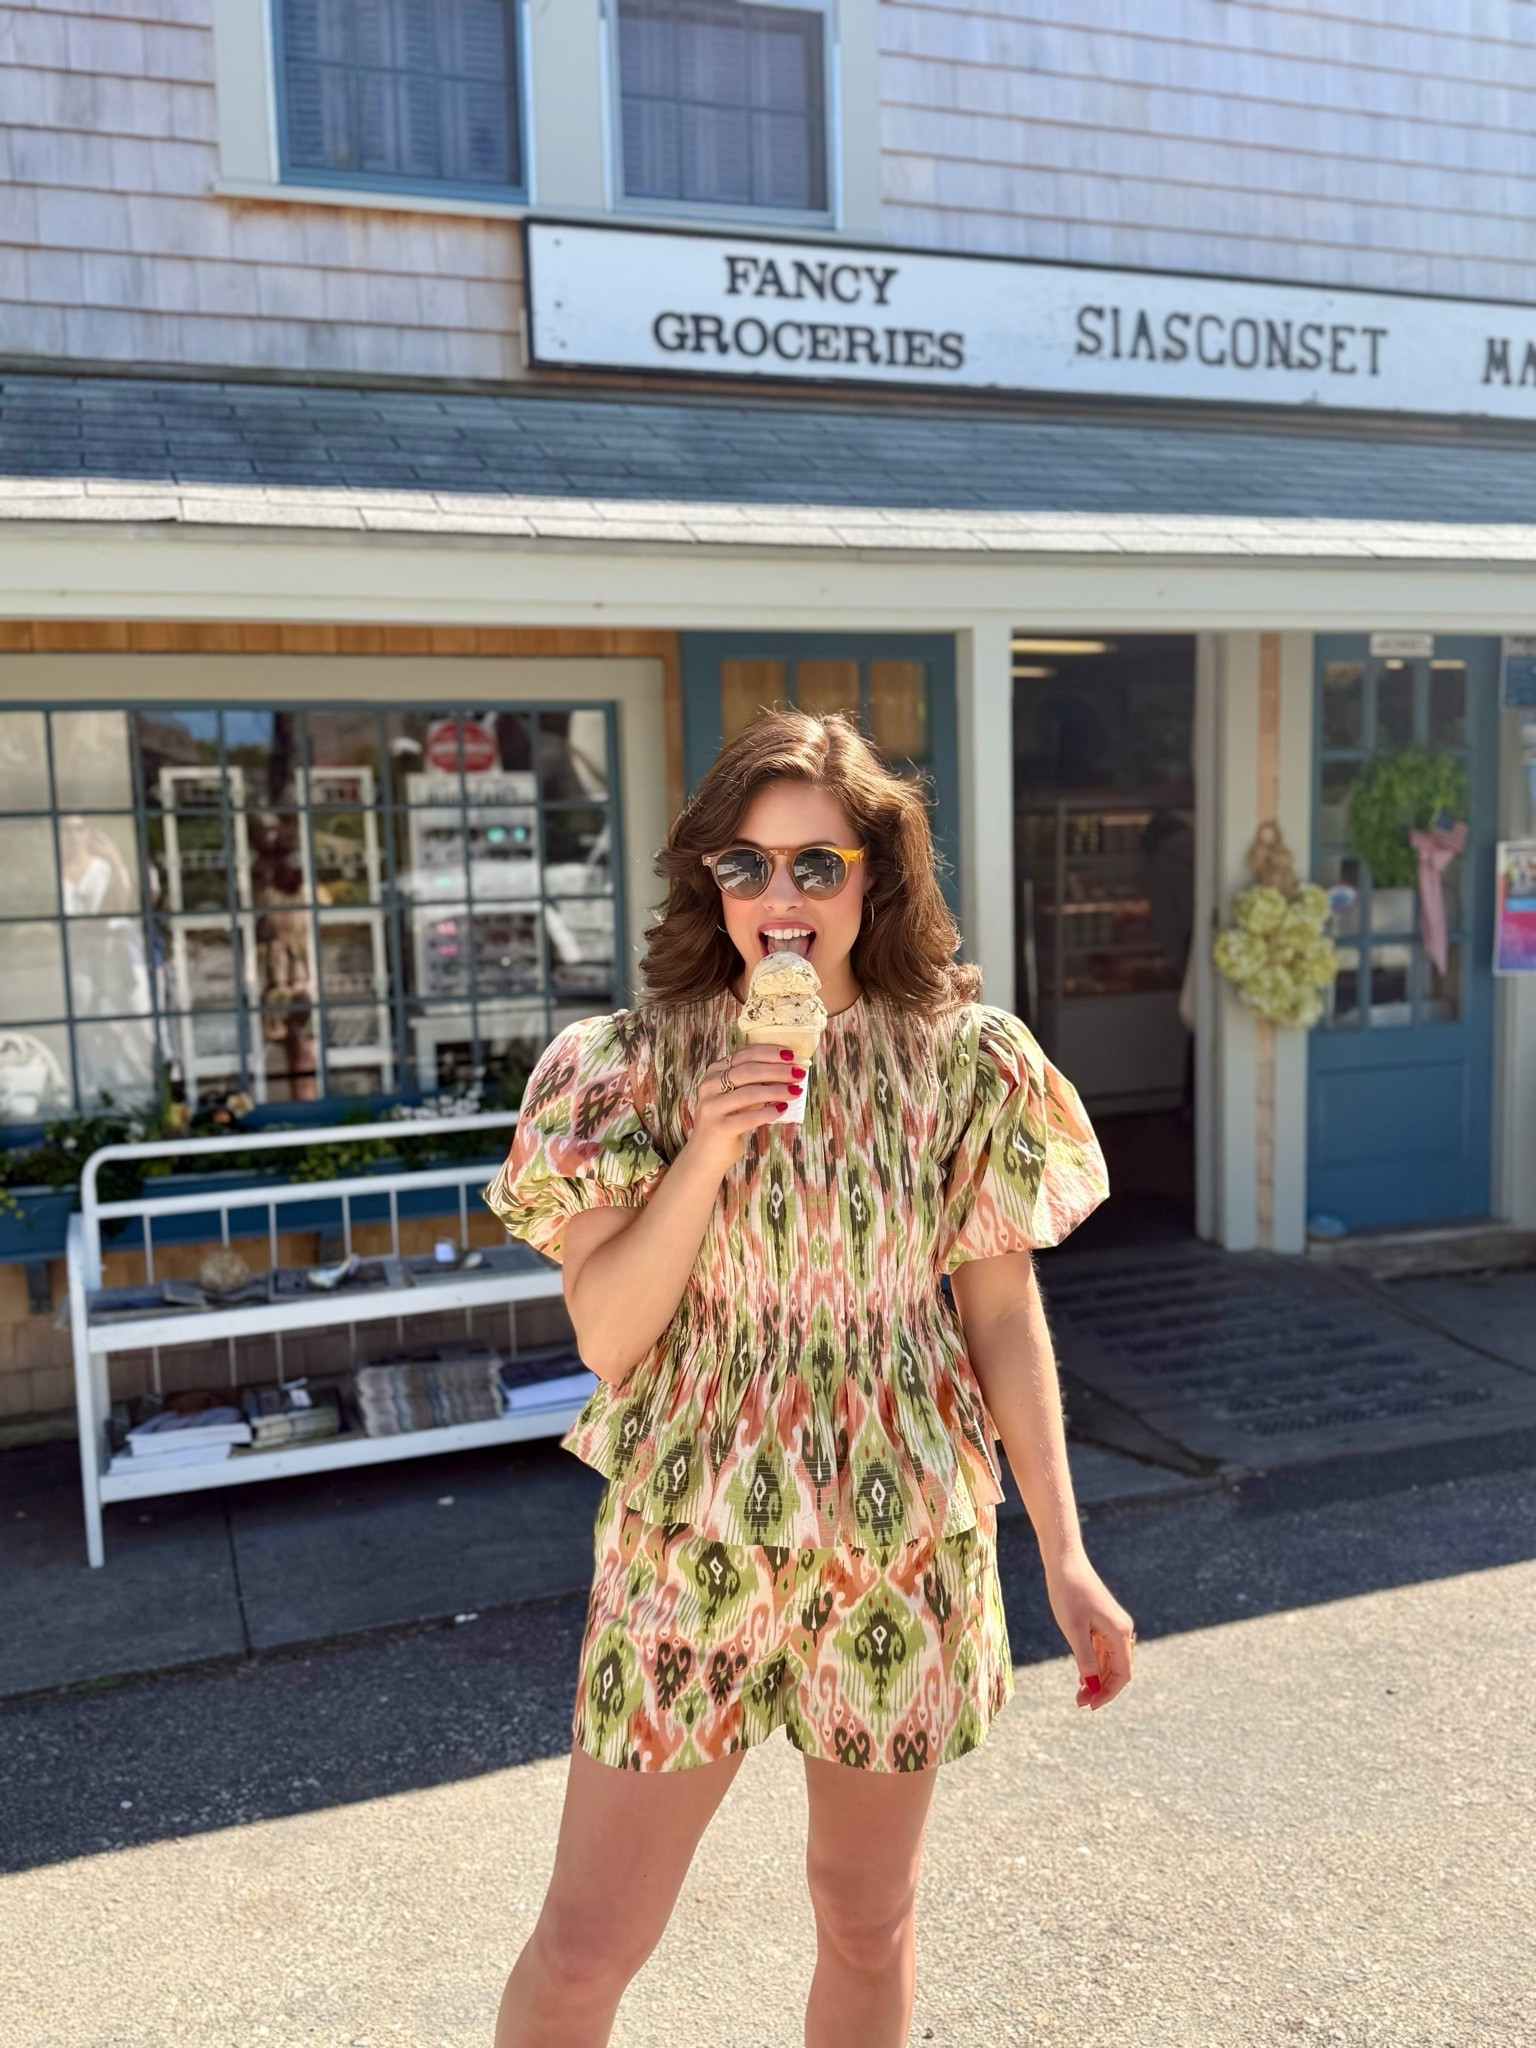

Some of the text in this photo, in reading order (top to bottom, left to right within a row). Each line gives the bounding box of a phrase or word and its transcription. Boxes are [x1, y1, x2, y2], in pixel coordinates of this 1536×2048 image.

[726, 255, 897, 305] FANCY
[654, 312, 964, 369] GROCERIES
[1076, 306, 1389, 376] SIASCONSET
